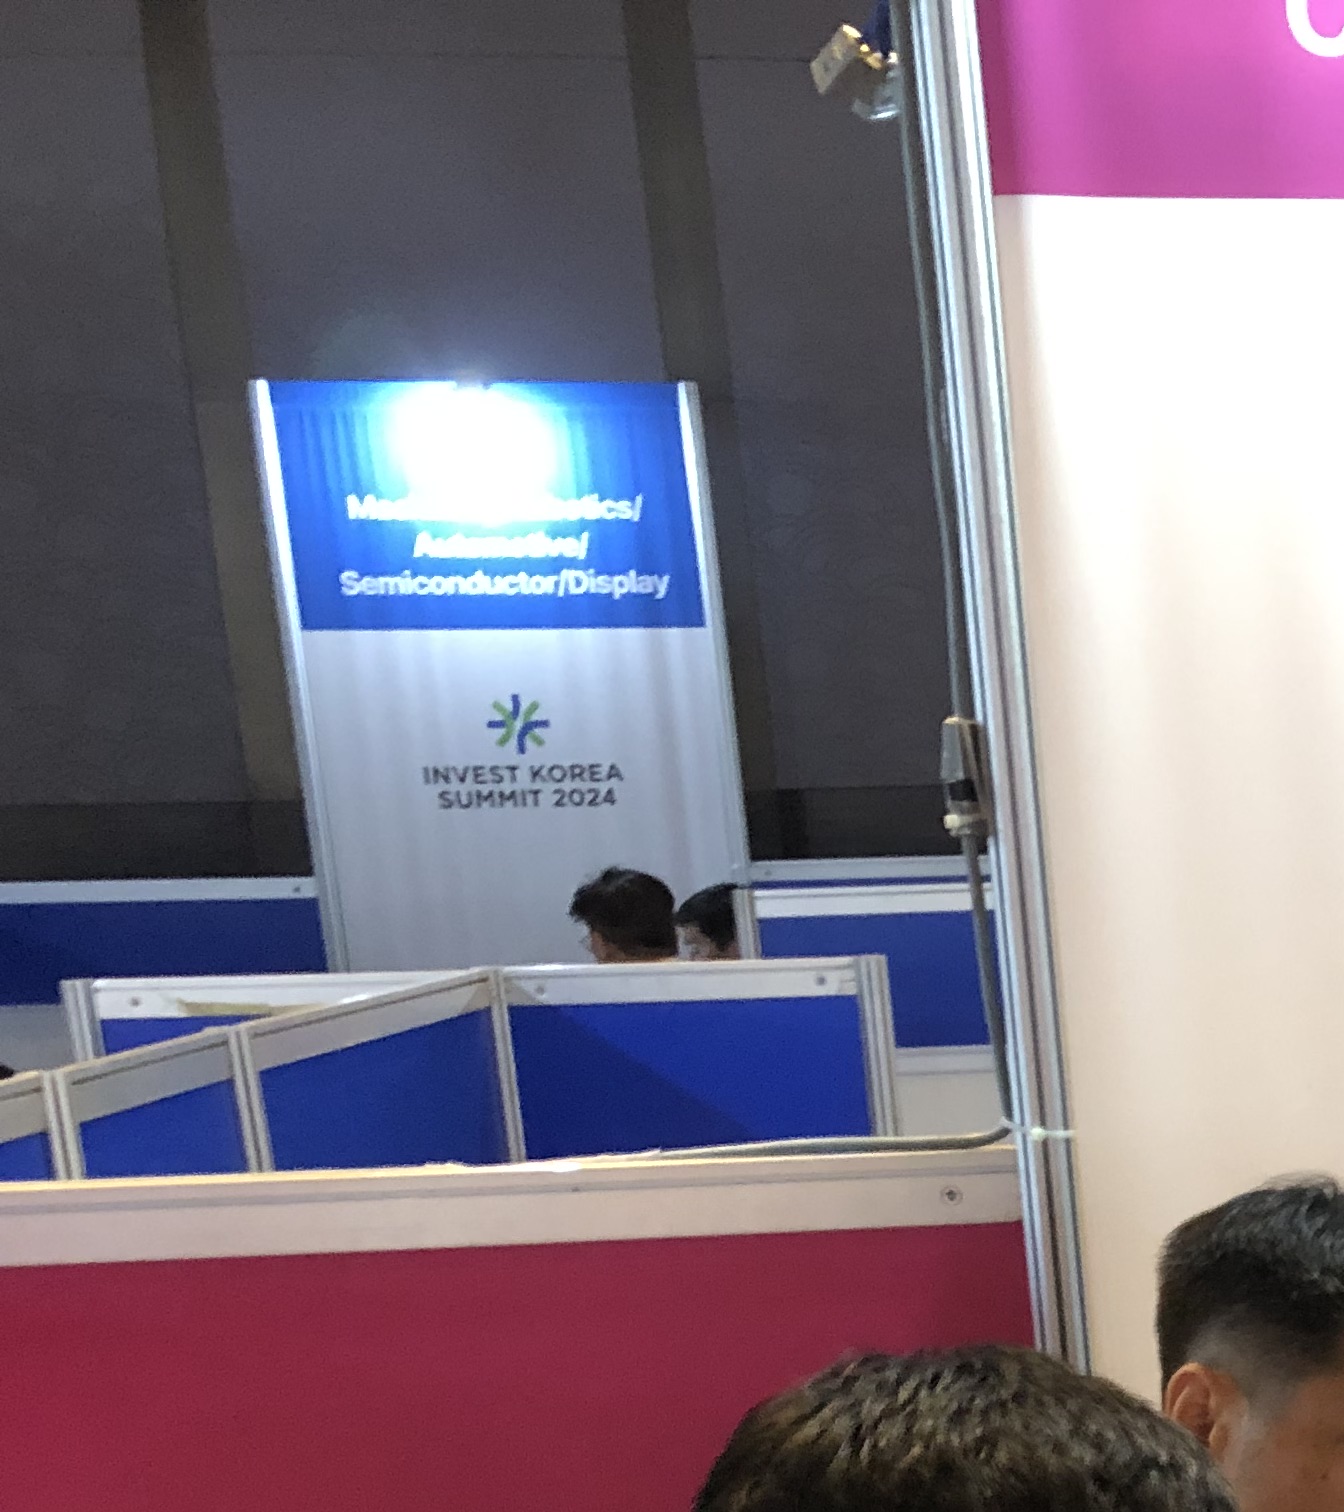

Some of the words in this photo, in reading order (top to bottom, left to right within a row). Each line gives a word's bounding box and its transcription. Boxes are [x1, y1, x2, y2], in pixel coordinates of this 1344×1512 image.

[339, 568, 670, 600] Semiconductor/Display
[422, 764, 519, 785] INVEST
[529, 762, 624, 783] KOREA
[437, 789, 543, 810] SUMMIT
[552, 786, 618, 808] 2024
